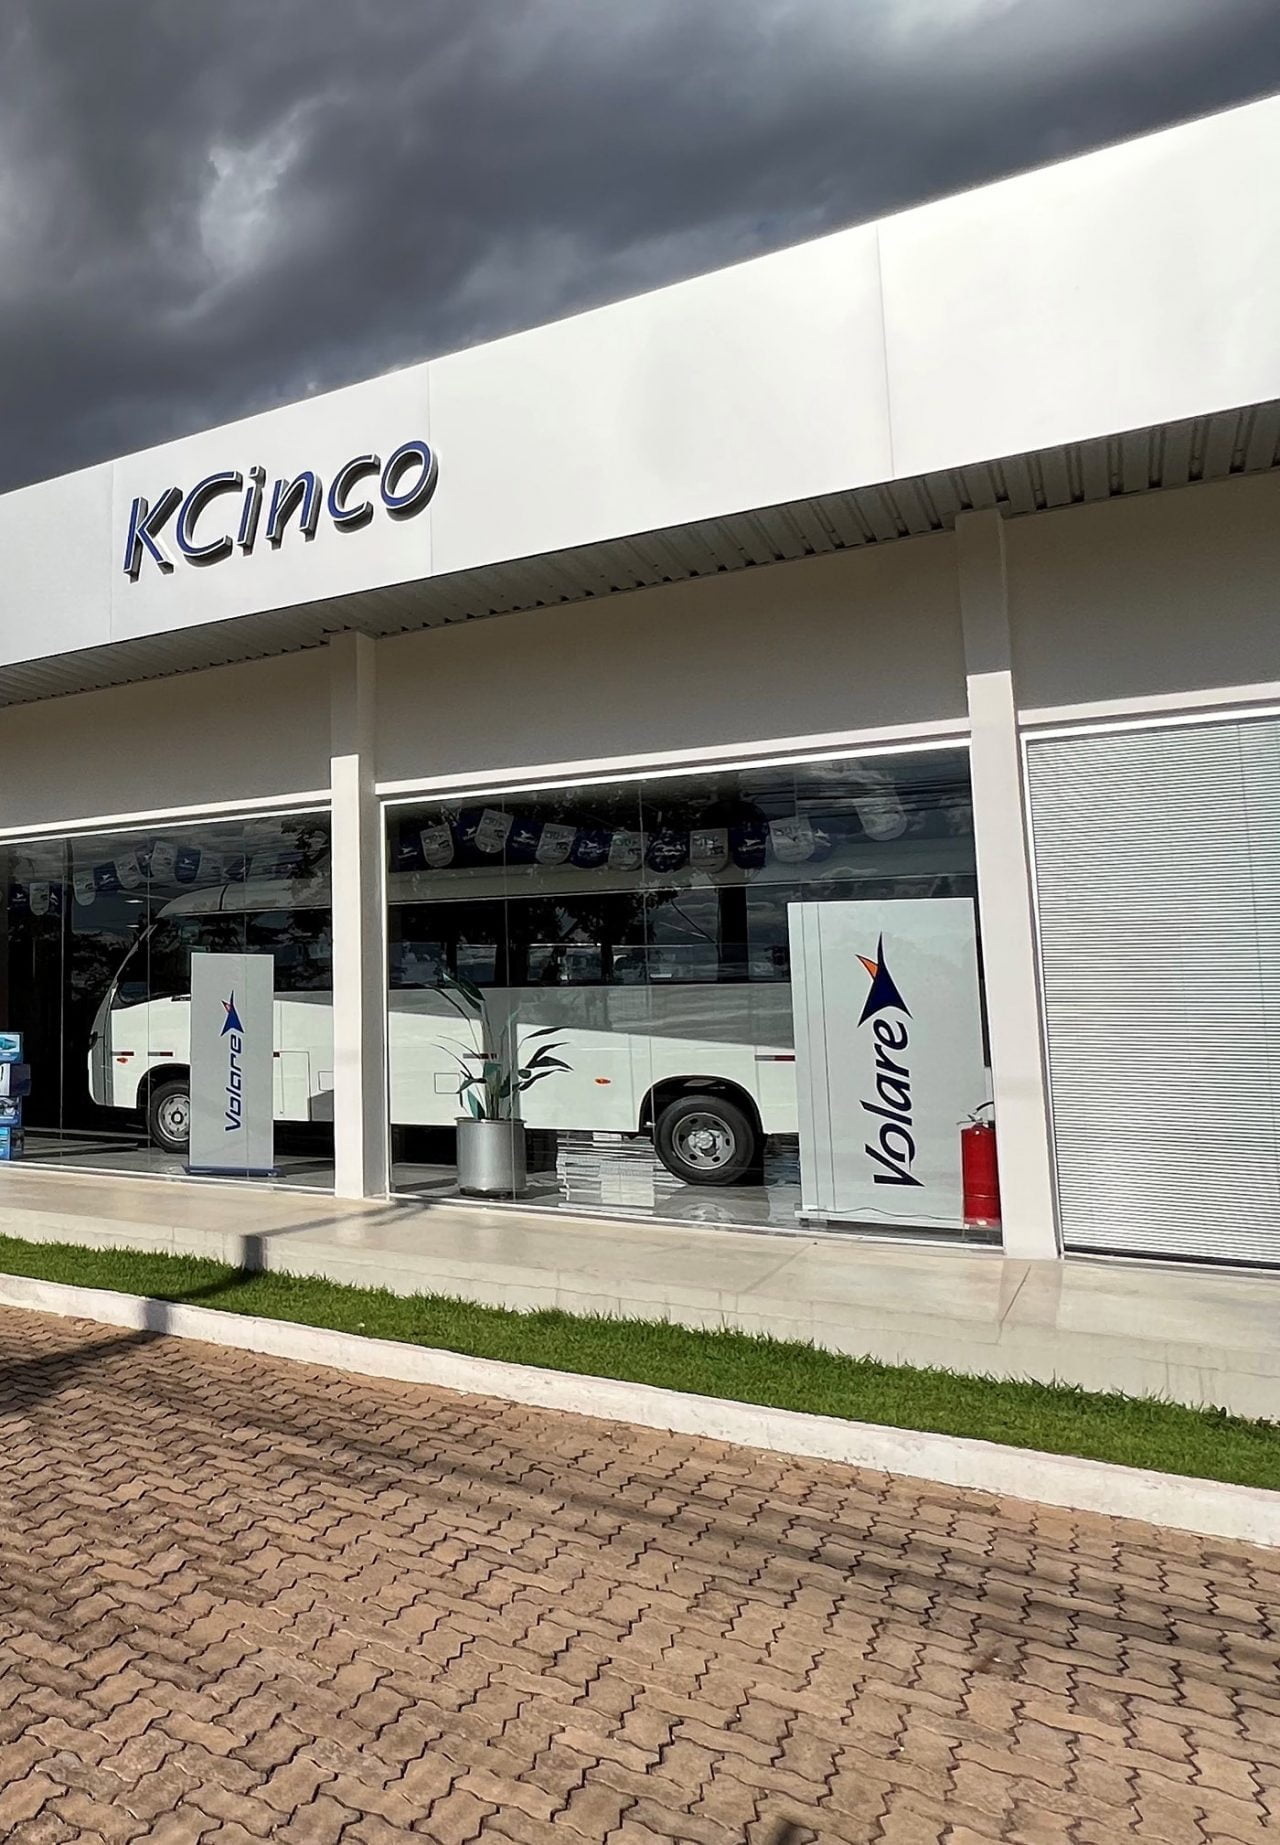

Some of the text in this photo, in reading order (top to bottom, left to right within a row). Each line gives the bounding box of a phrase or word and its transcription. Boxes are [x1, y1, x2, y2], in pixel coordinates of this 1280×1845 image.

[123, 440, 438, 582] KCinco
[225, 1034, 242, 1131] Volare
[859, 1018, 925, 1187] Volare
